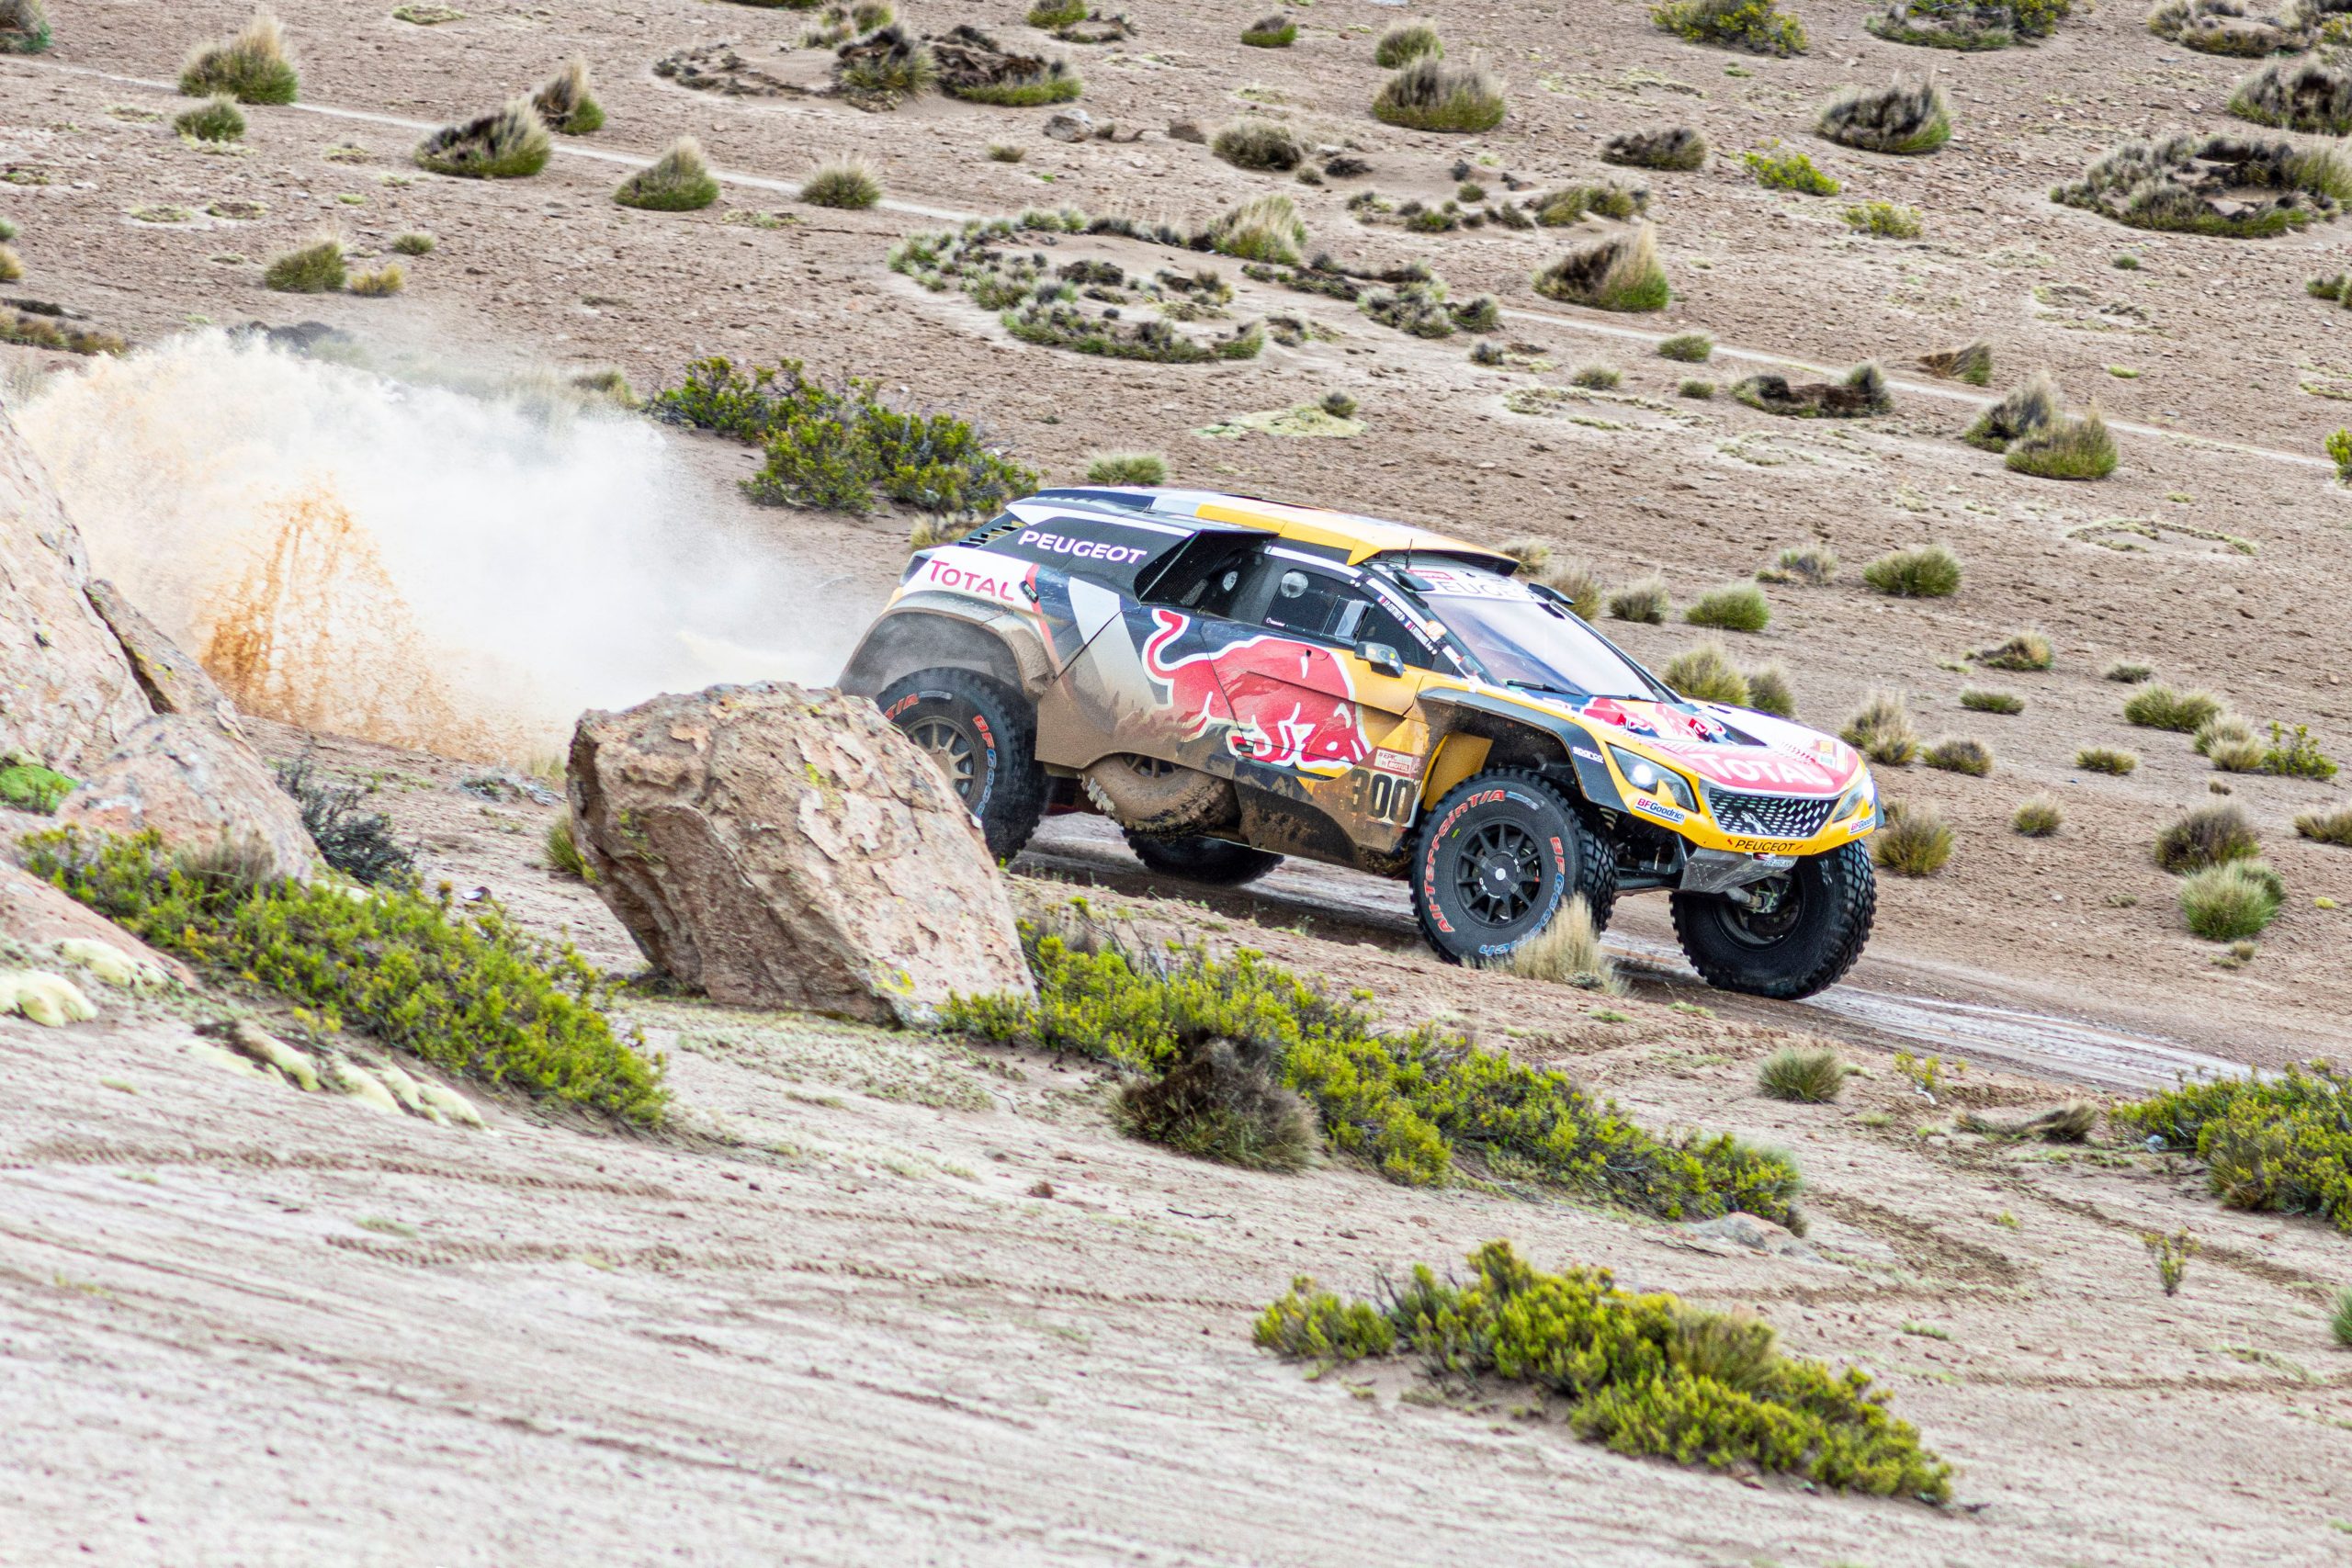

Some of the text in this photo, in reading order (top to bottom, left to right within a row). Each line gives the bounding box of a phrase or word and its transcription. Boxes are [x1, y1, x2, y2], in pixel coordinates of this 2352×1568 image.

[1018, 530, 1148, 564] PEUGEOT
[931, 559, 1015, 602] TOTAL
[972, 714, 998, 818] BFGood
[1572, 746, 1604, 763] sparco
[1687, 753, 1835, 786] TOTAL
[1345, 768, 1416, 824] 300
[1636, 797, 1685, 821] BFGoodrich
[1735, 840, 1796, 852] PEUGEOT
